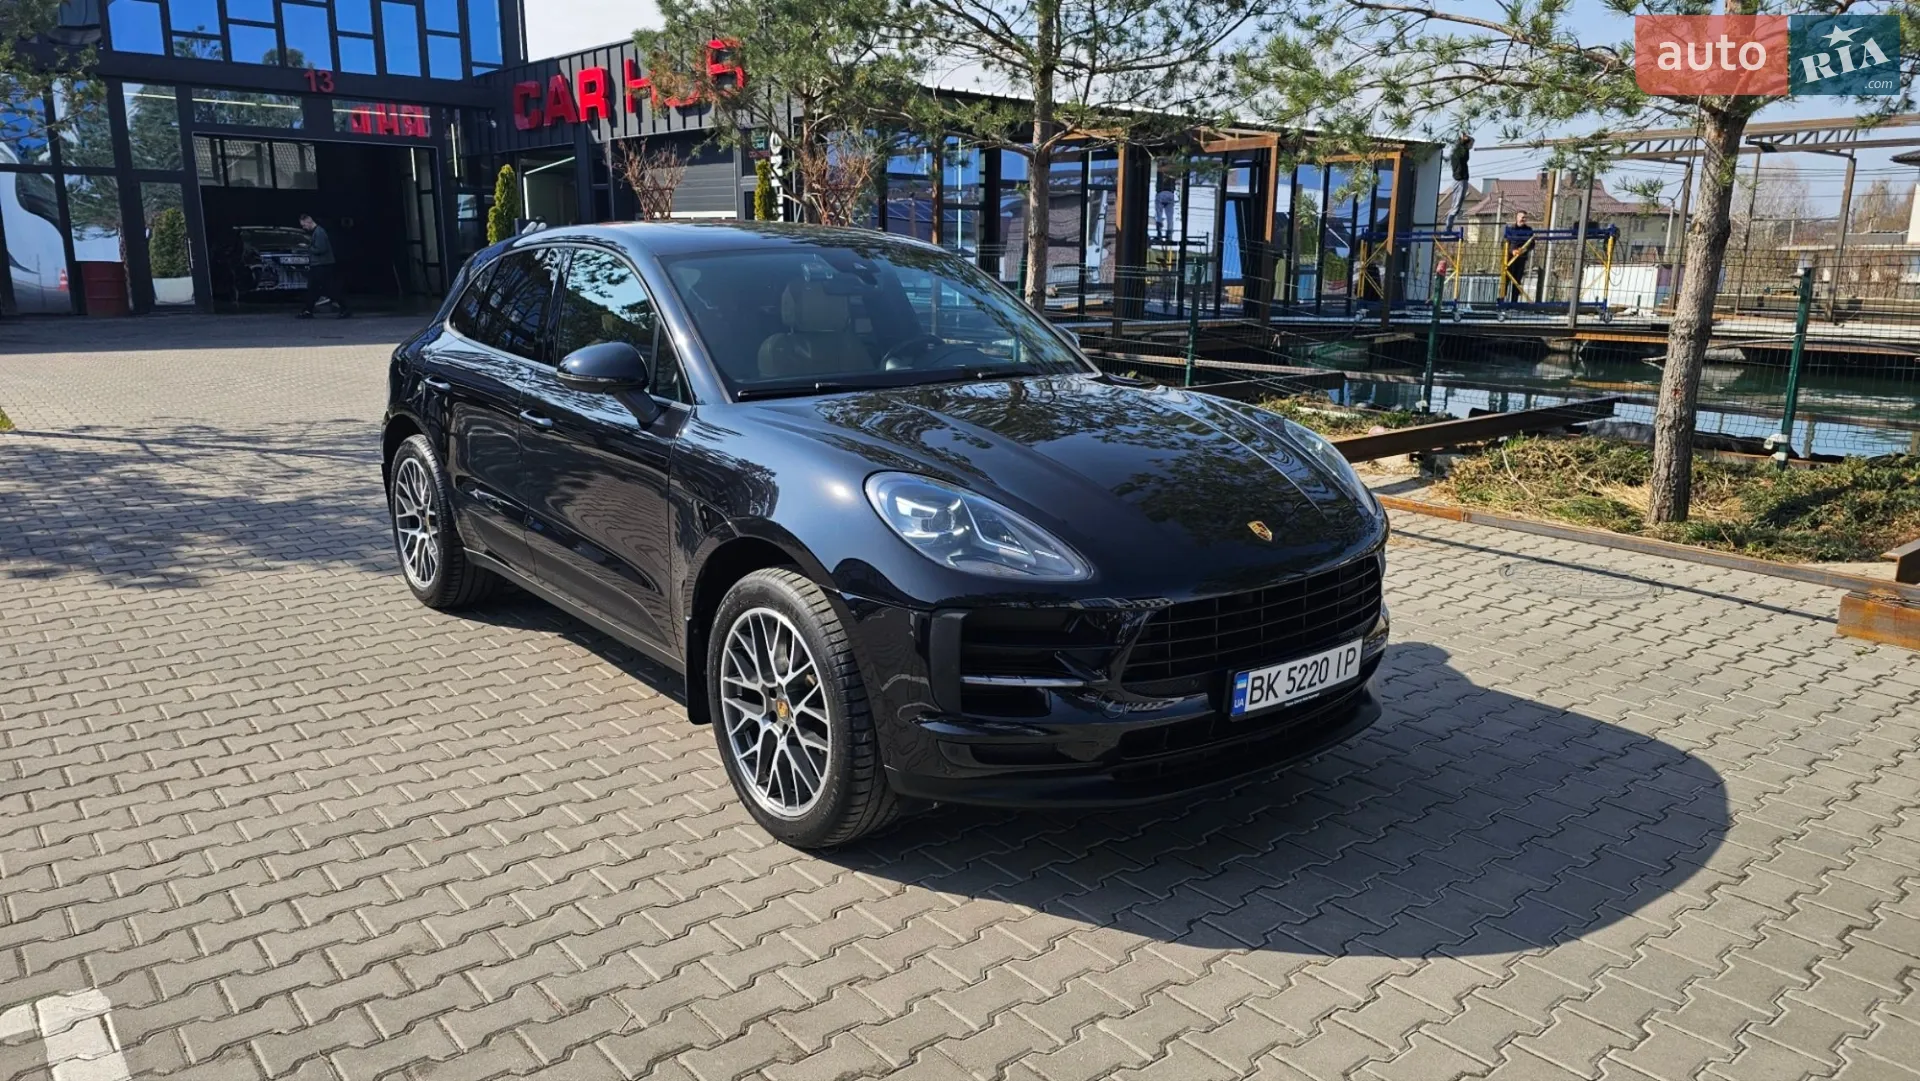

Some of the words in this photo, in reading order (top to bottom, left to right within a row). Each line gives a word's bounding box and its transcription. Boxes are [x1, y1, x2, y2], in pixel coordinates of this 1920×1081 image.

[304, 69, 335, 93] 13
[512, 65, 611, 131] CAR
[1248, 670, 1282, 705] BK
[1285, 657, 1330, 695] 5220
[1234, 698, 1245, 709] UA
